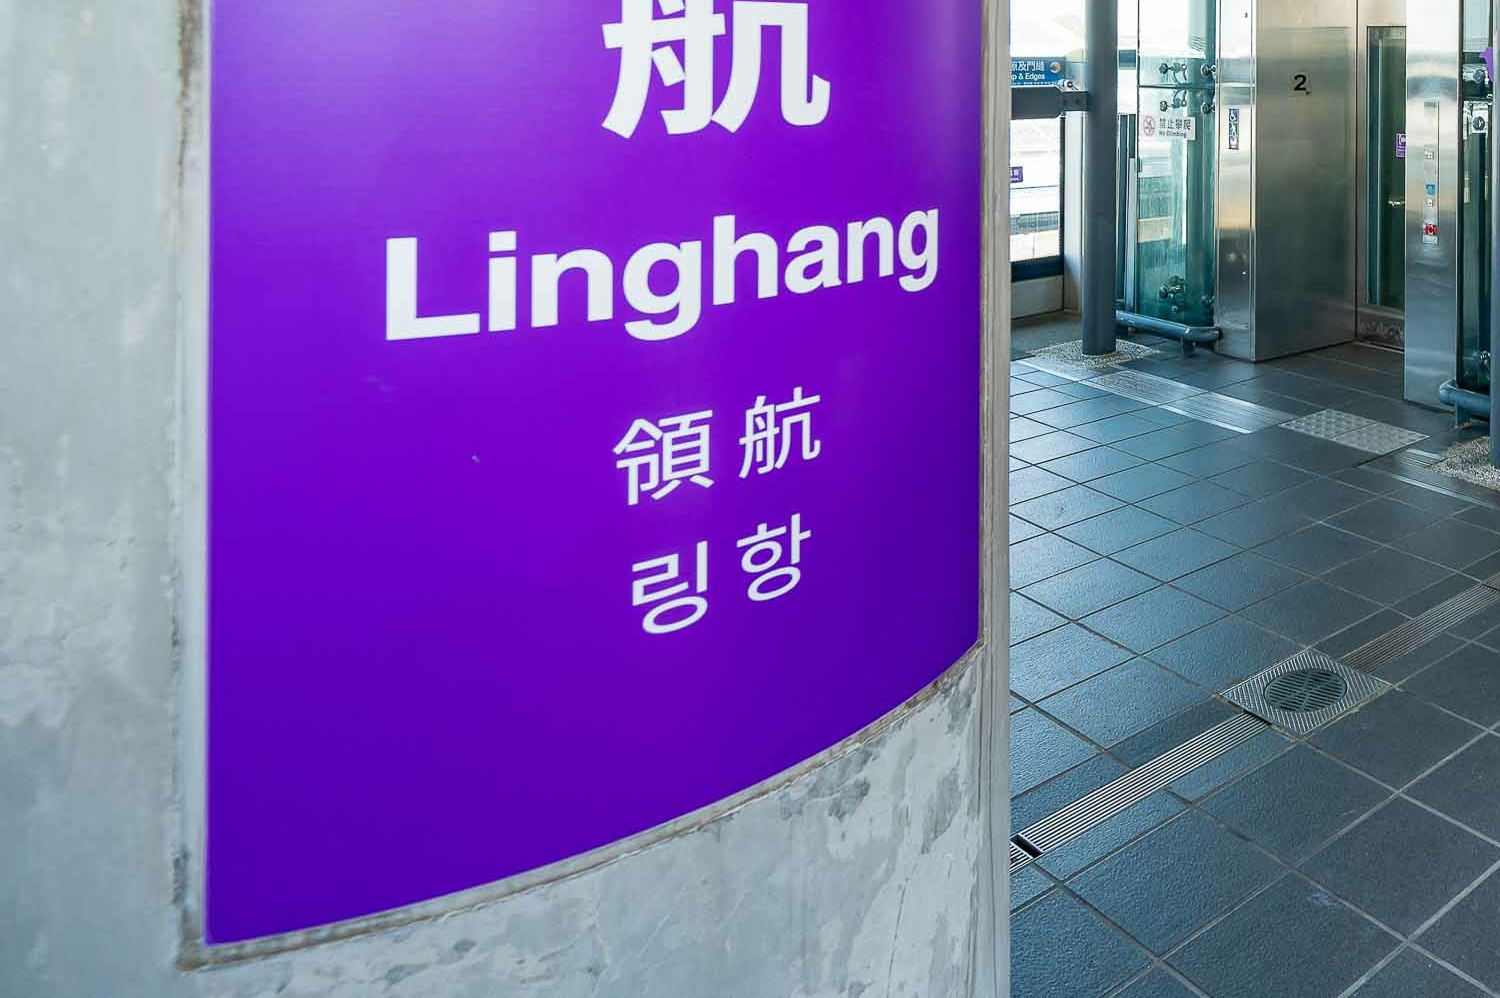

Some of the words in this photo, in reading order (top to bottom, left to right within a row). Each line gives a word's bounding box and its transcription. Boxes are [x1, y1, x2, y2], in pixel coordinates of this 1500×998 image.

[1025, 72, 1046, 81] Edges
[1294, 74, 1307, 91] 2
[385, 207, 939, 342] Linghang
